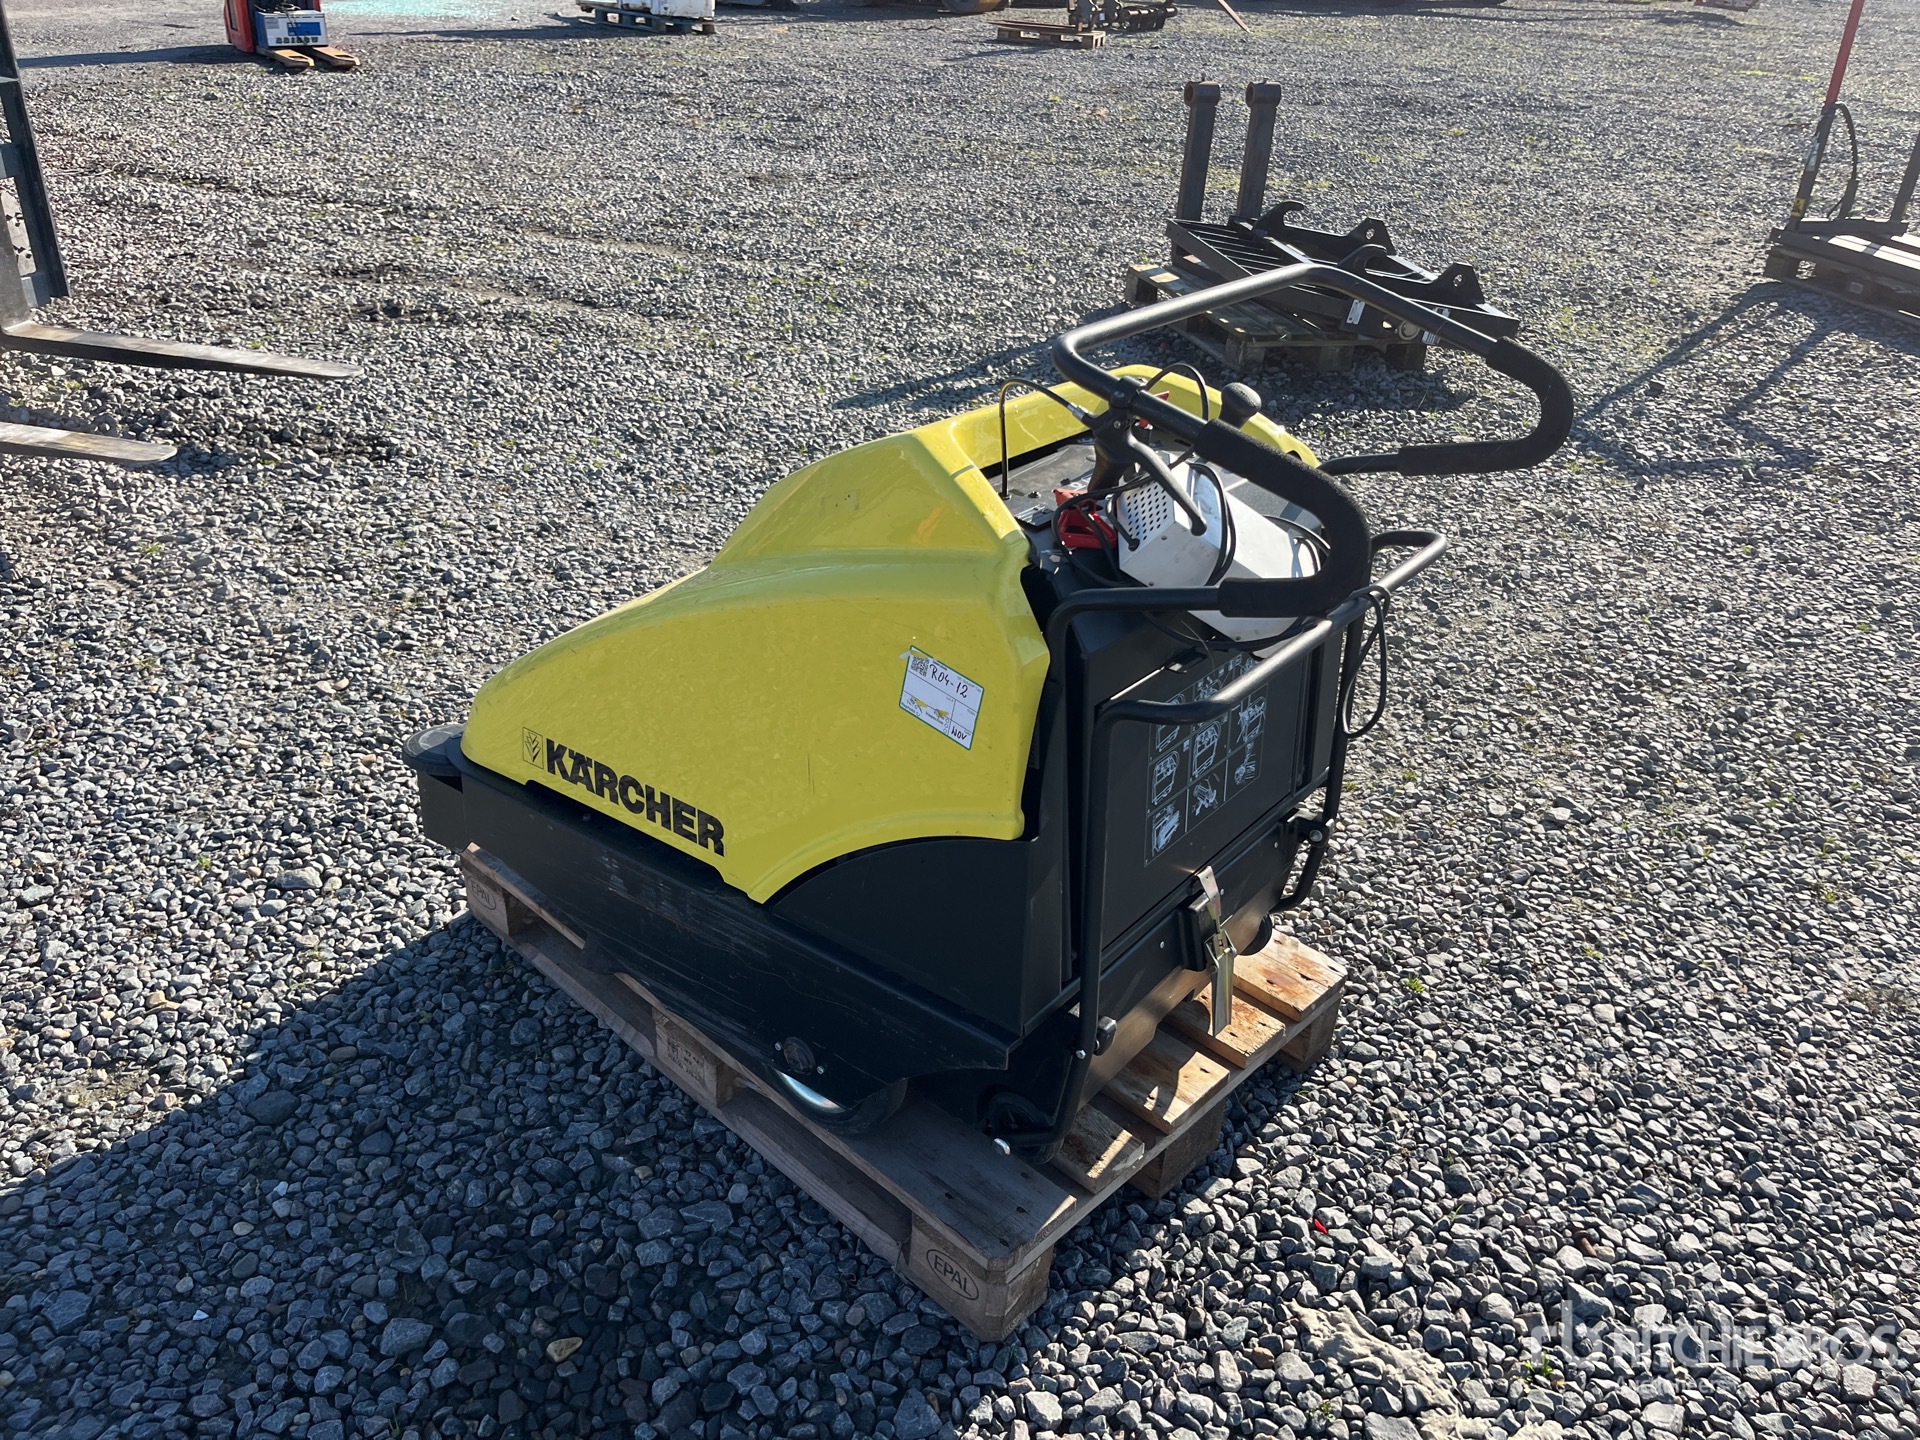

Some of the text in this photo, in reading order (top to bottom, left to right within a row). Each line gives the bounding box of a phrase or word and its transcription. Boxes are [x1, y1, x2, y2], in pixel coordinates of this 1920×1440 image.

[929, 663, 969, 699] R04-12
[546, 737, 725, 858] KÄRCHER
[471, 880, 494, 908] EPAL
[933, 1254, 973, 1297] EPAL
